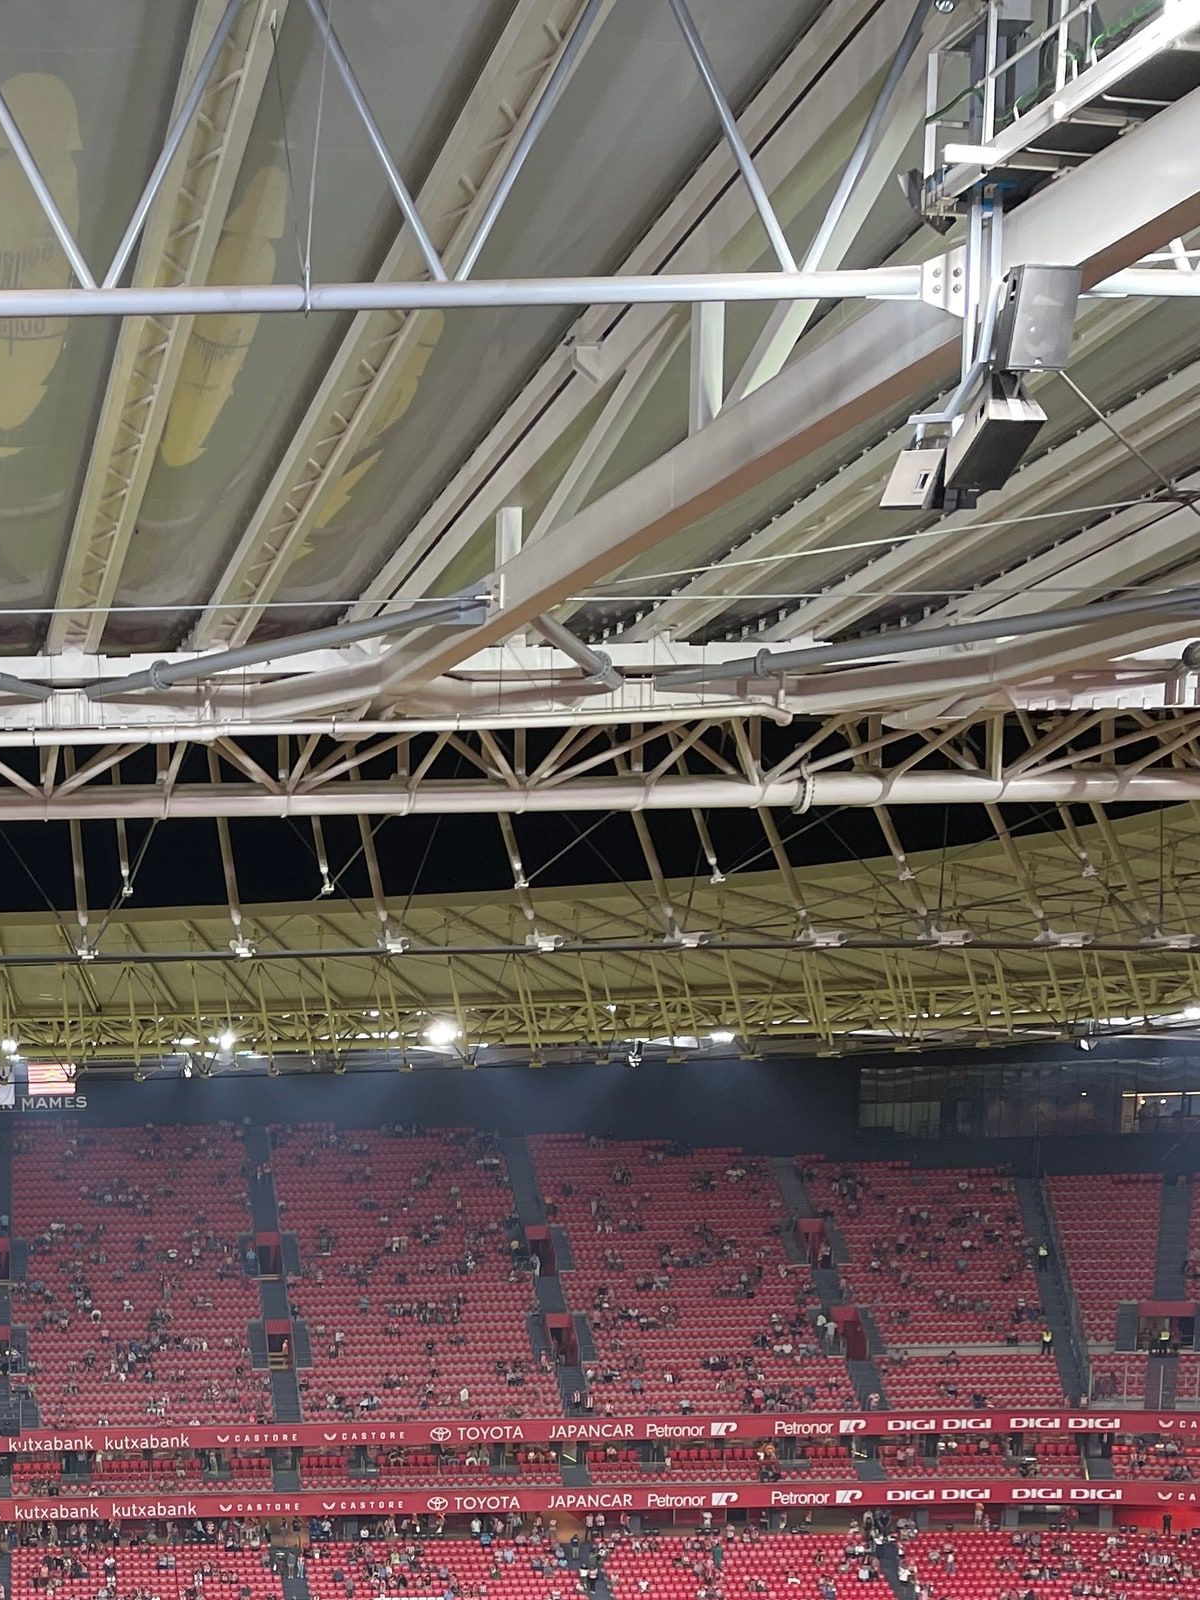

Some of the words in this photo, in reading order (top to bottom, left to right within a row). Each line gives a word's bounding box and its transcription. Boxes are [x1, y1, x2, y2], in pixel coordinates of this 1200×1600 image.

[22, 1096, 88, 1112] MAMES
[775, 1421, 834, 1434] Petronor
[888, 1420, 935, 1430] DIGI
[943, 1419, 991, 1429] DIGI
[1010, 1418, 1060, 1428] DIGI
[1068, 1418, 1120, 1428] DIGI
[342, 1432, 404, 1440] CASTORE
[457, 1426, 523, 1440] TOYOTA
[549, 1424, 633, 1438] JAPANCAR
[646, 1422, 705, 1438] Petronor
[9, 1437, 93, 1451] kutxabank
[105, 1434, 189, 1449] kutxabank
[235, 1434, 297, 1442] CASTORE
[772, 1491, 830, 1504] Petronor
[887, 1490, 934, 1500] DIGI
[942, 1489, 990, 1499] DIGI
[1012, 1489, 1062, 1498] DIGI
[1071, 1489, 1122, 1499] DIGI
[238, 1503, 299, 1511] CASTORE
[341, 1501, 403, 1509] CASTORE
[455, 1496, 520, 1509] TOYOTA
[548, 1494, 632, 1508] JAPANCAR
[648, 1494, 706, 1507] Petronor
[15, 1505, 99, 1519] kutxabank
[113, 1502, 196, 1516] kutxabank
